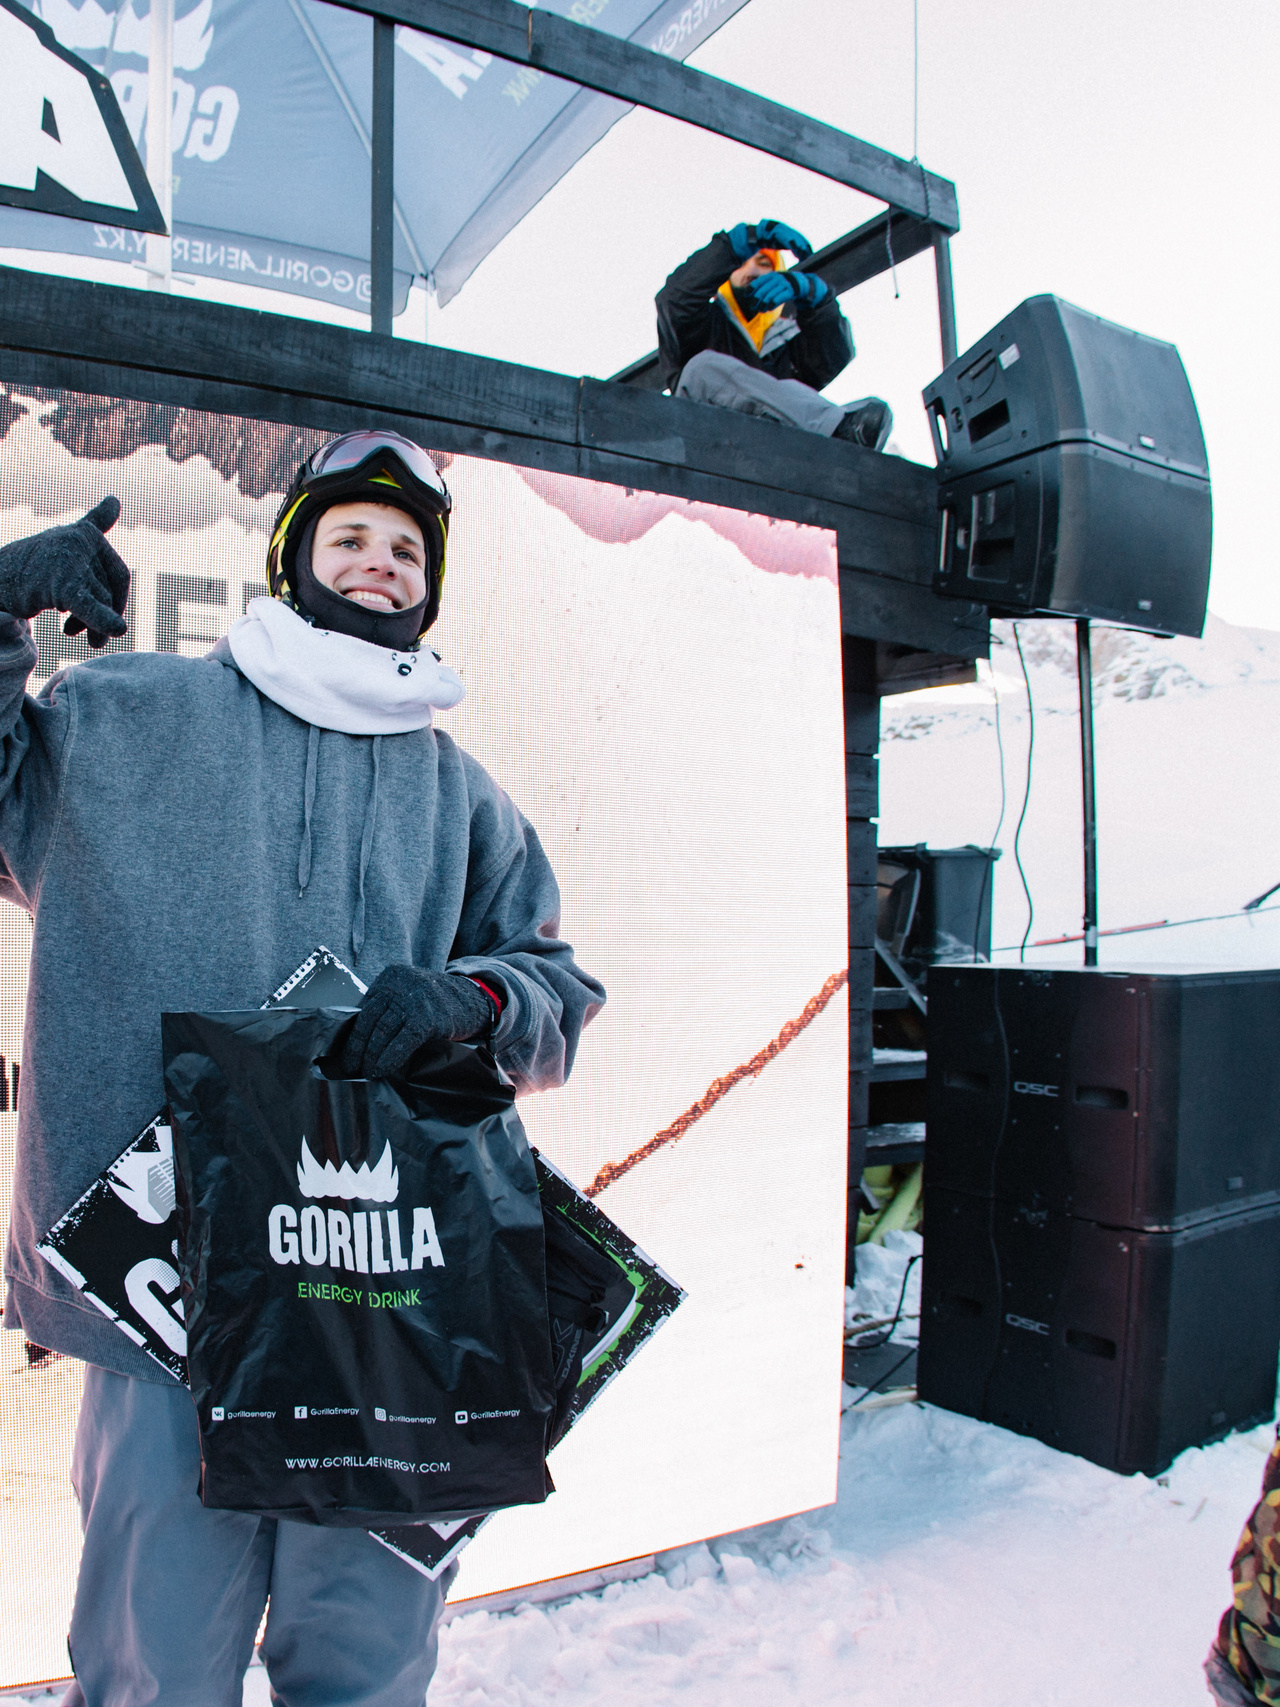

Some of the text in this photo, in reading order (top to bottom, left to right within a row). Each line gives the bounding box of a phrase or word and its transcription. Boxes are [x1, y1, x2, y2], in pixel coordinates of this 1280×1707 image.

[1013, 1081, 1059, 1098] QSC
[268, 1204, 446, 1274] GORILLA
[298, 1282, 422, 1308] ENERGY DRINK
[1005, 1313, 1050, 1336] QSC
[227, 1410, 276, 1420] gorillaenergy
[310, 1407, 360, 1417] GorillaEnergy
[388, 1414, 437, 1425] gorillaenergy
[470, 1408, 521, 1420] GorillaEnergy
[285, 1456, 451, 1473] WWW.GORILLAENERGY.COM
